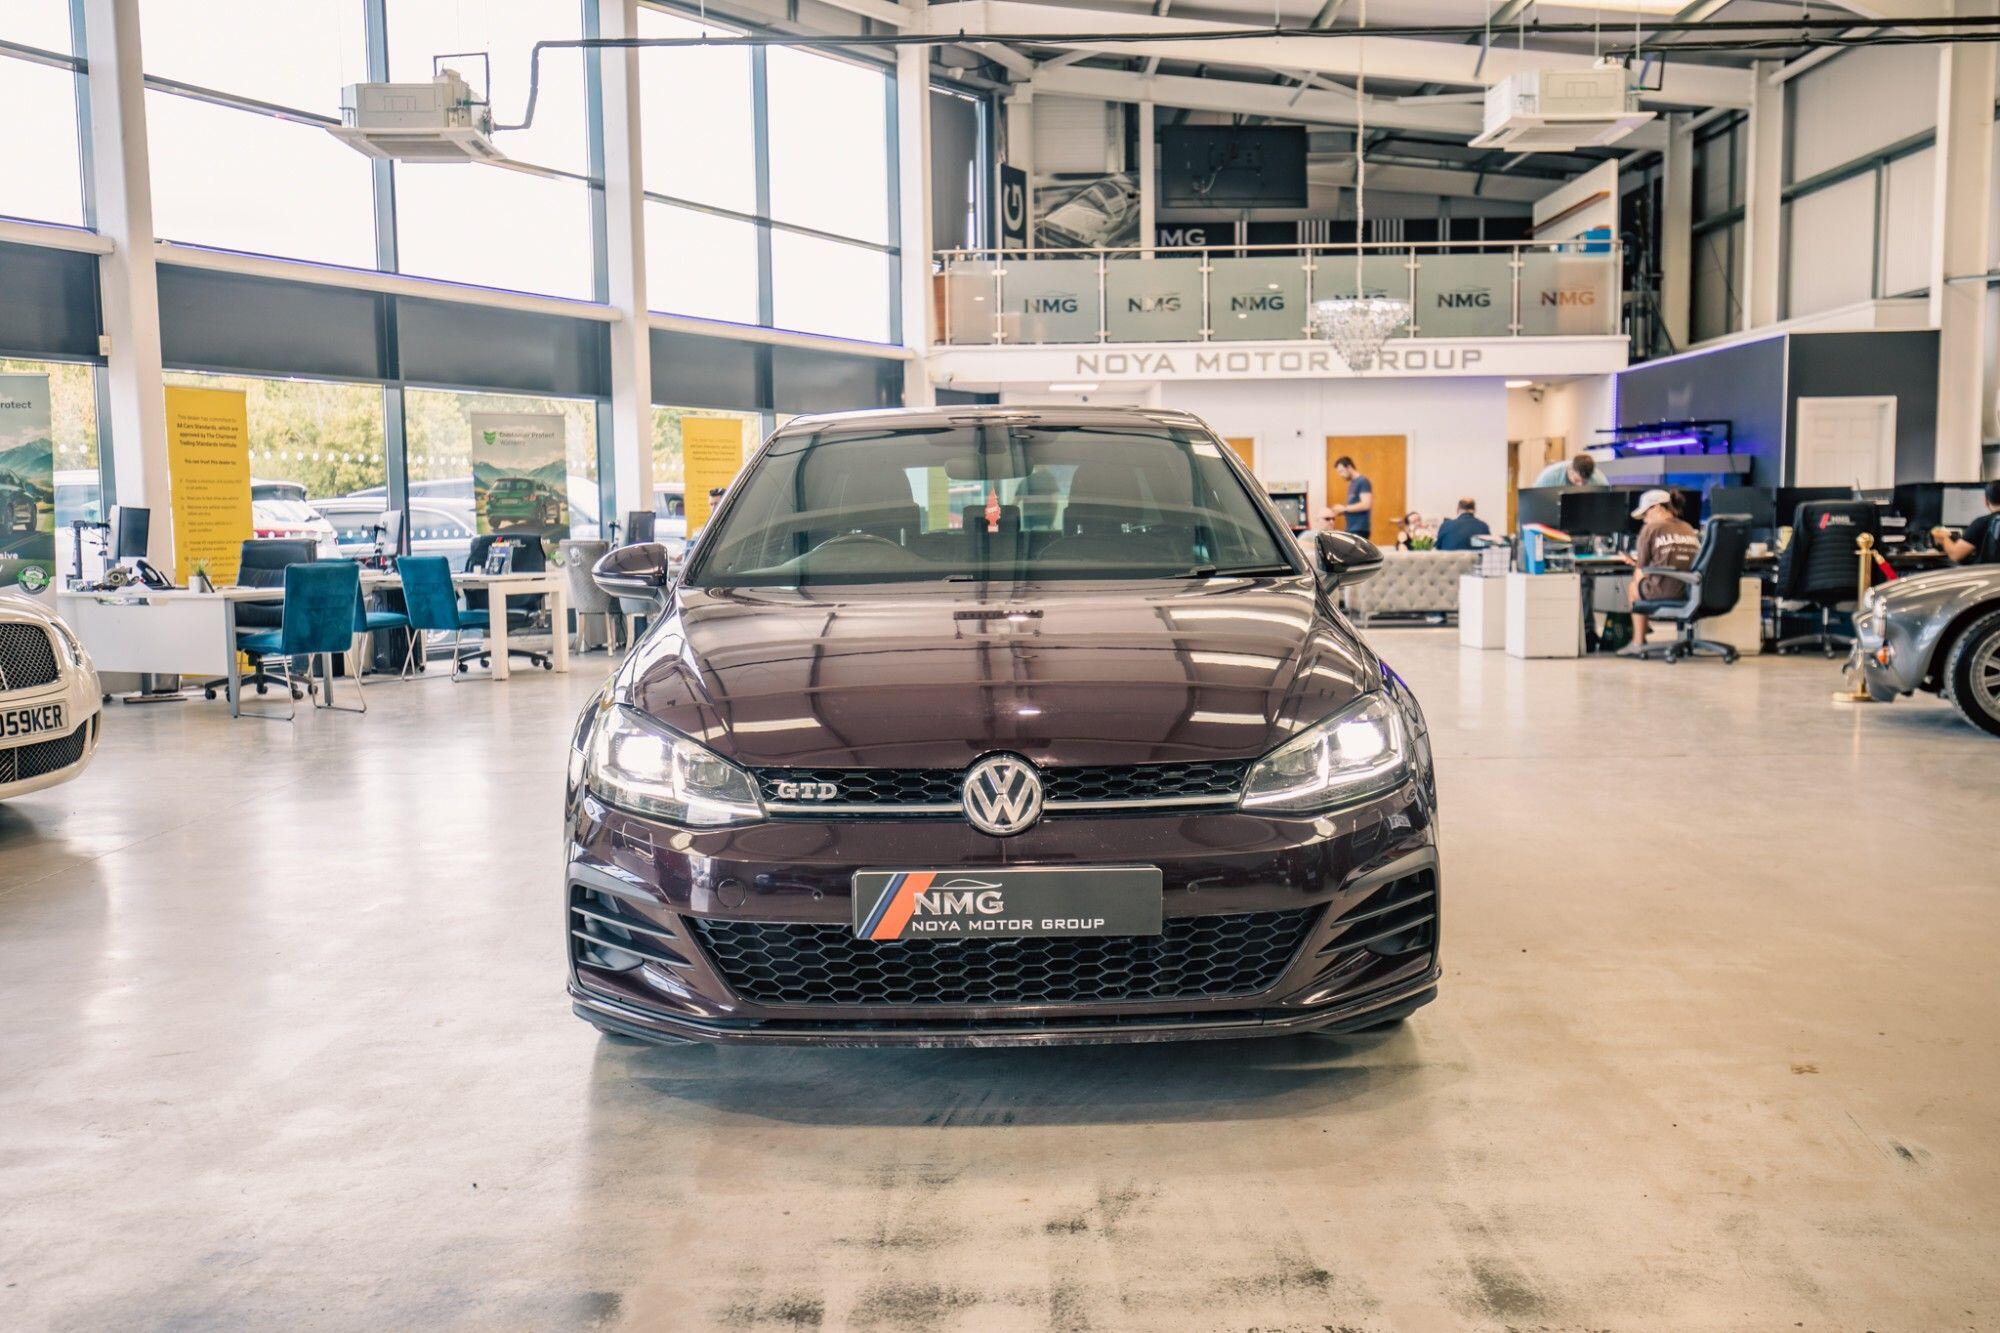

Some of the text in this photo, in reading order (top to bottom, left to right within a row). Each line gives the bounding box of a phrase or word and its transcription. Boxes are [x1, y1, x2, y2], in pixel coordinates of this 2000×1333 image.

[1155, 229, 1206, 247] MG
[1024, 298, 1078, 313] NMG
[1231, 296, 1285, 311] NMG
[1437, 293, 1491, 308] NMG
[1541, 291, 1595, 306] NMG
[1076, 353, 1176, 375] NOYA
[1195, 351, 1330, 373] MOTOR
[777, 782, 838, 799] GTD
[913, 891, 1004, 915] NMG
[912, 918, 1105, 931] NOYA MOTOR GROUP
